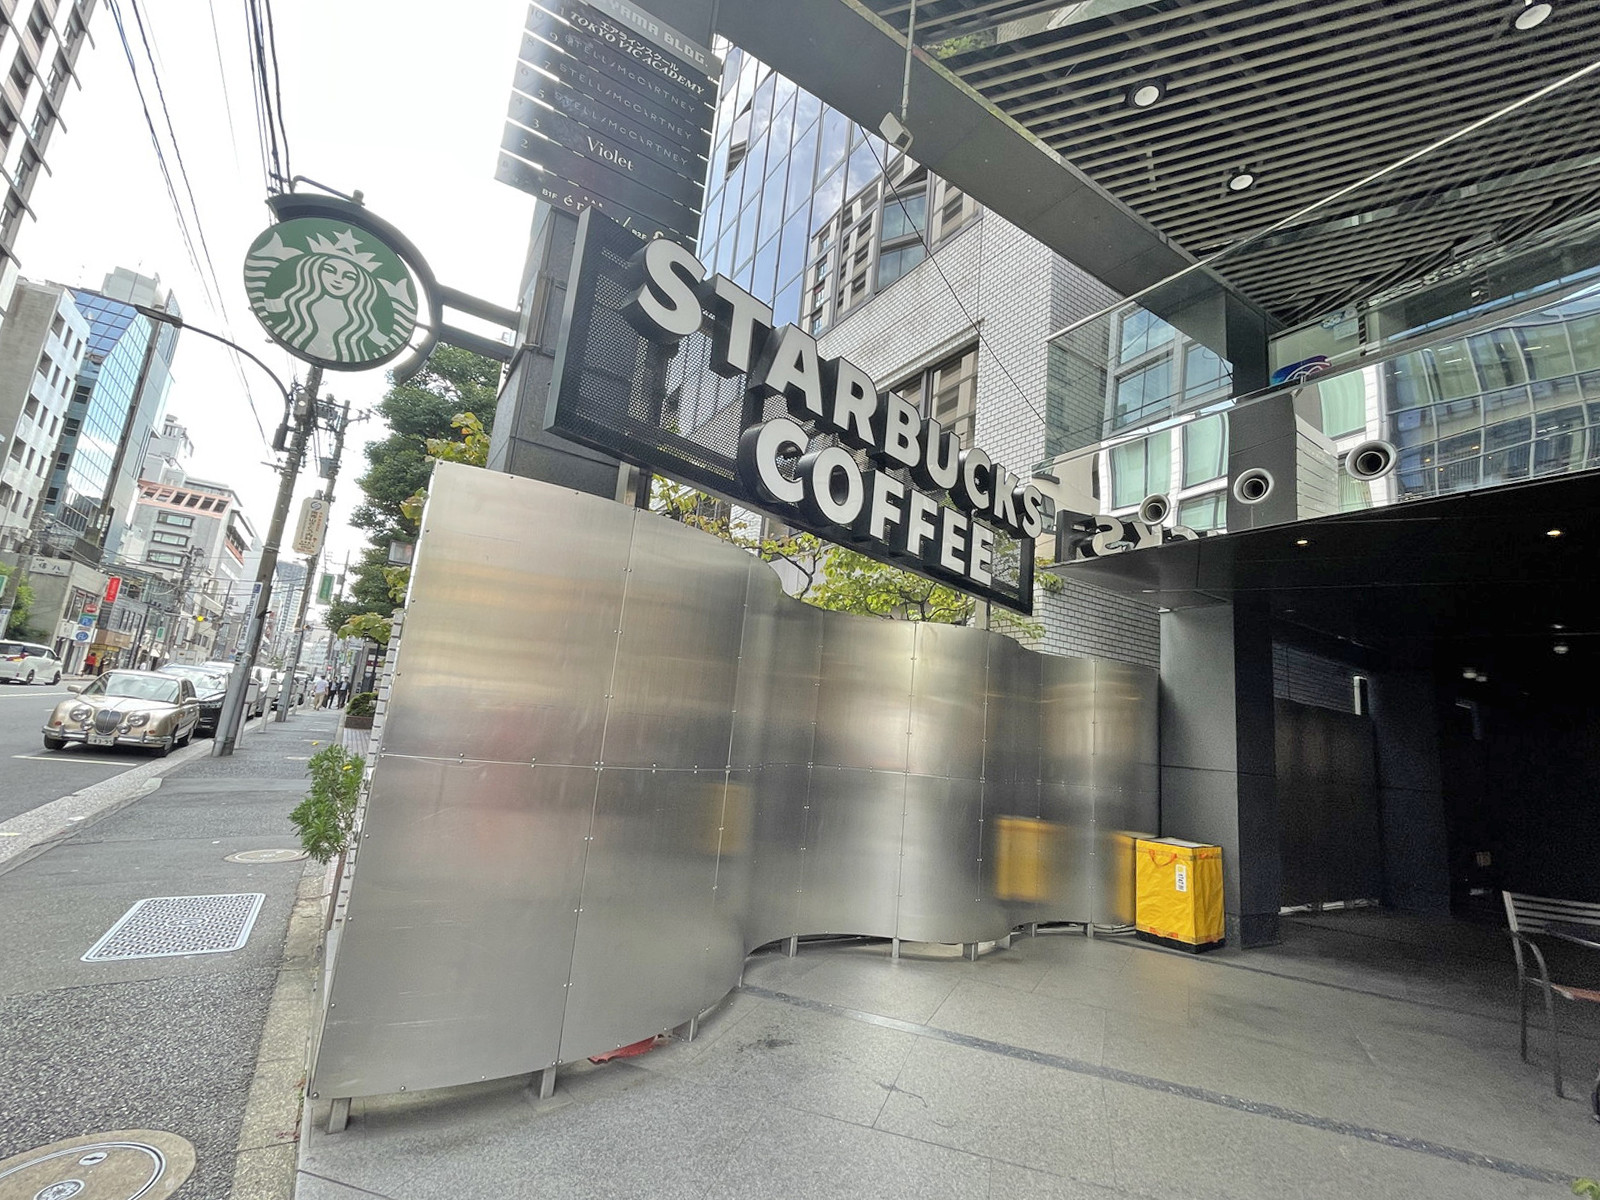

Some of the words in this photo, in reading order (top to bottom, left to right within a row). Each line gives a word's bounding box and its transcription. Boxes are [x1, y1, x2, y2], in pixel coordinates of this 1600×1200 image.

[549, 31, 558, 42] 9
[571, 11, 616, 43] TOKYO
[619, 40, 643, 58] VIC
[643, 56, 705, 95] ACADEMY
[600, 20, 680, 71] エアラインスクール
[663, 32, 708, 67] BLDG.
[544, 60, 552, 70] 7
[538, 88, 546, 99] 5
[532, 118, 541, 129] 3
[520, 138, 529, 149] 2
[587, 135, 634, 172] Violet
[636, 237, 1044, 541] STARBUCKS
[755, 417, 995, 587] COFFEE
